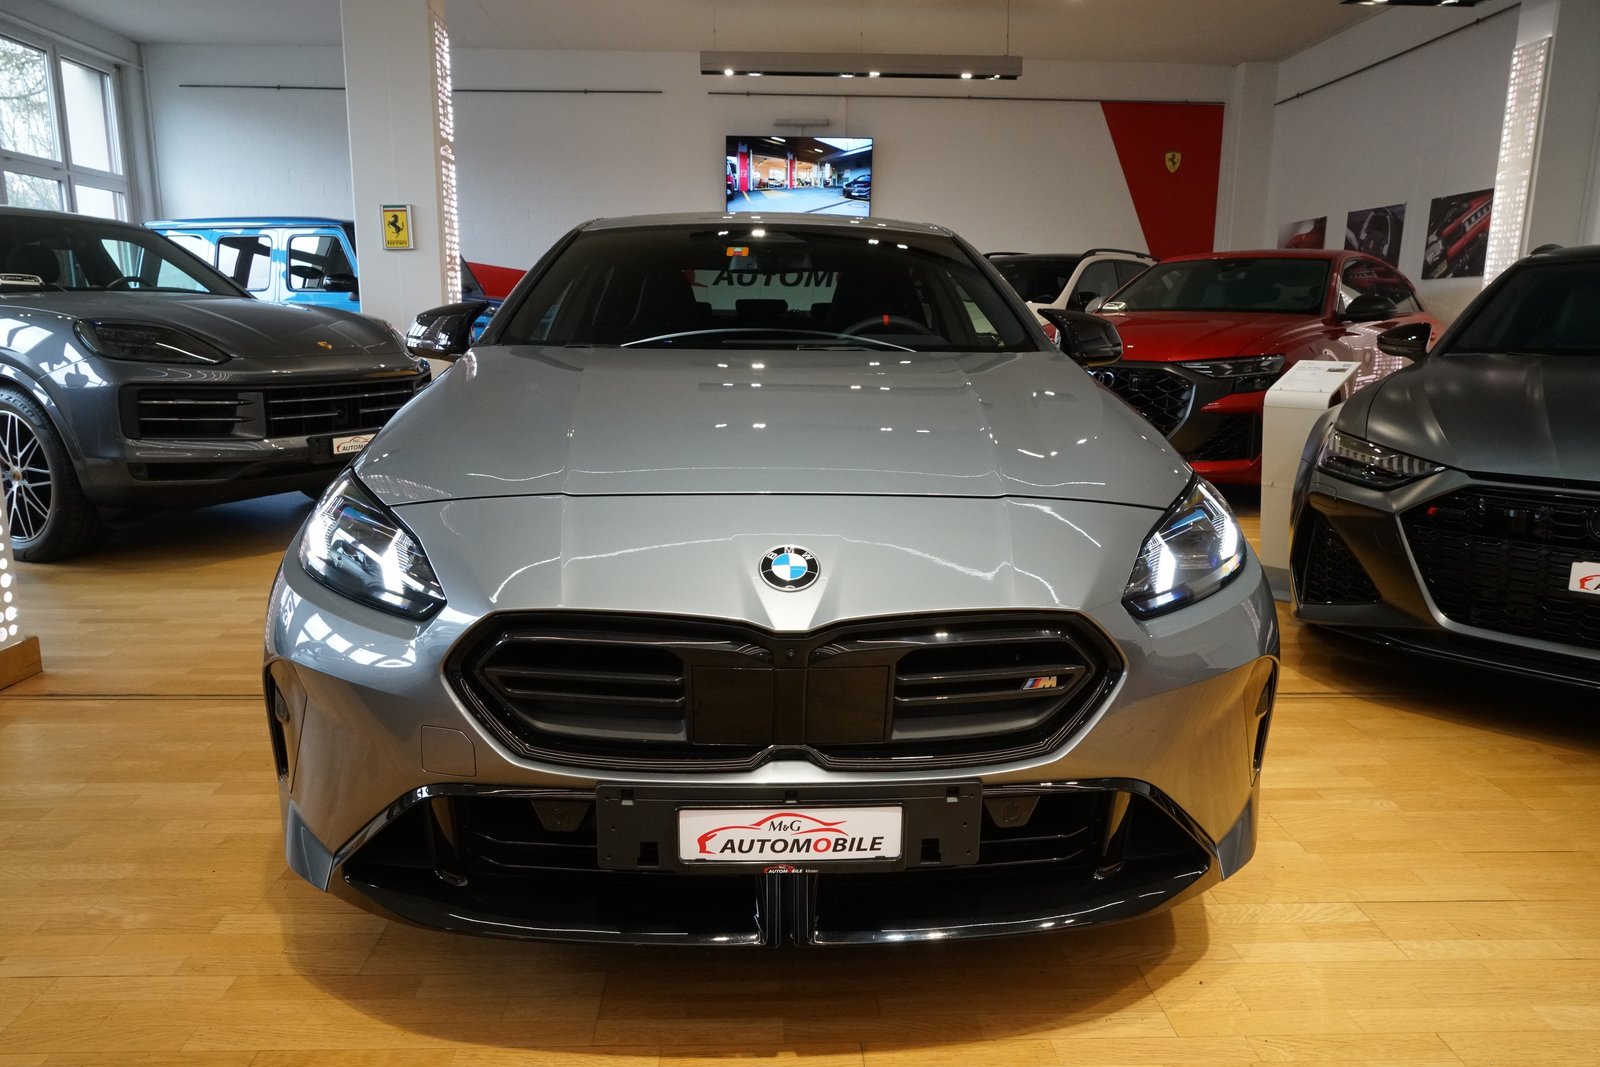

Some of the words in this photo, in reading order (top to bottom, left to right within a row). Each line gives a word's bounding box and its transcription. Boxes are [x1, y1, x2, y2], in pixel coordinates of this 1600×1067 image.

[766, 547, 813, 560] BMW
[768, 820, 802, 832] M&G
[719, 836, 885, 854] AUTOMOBILE
